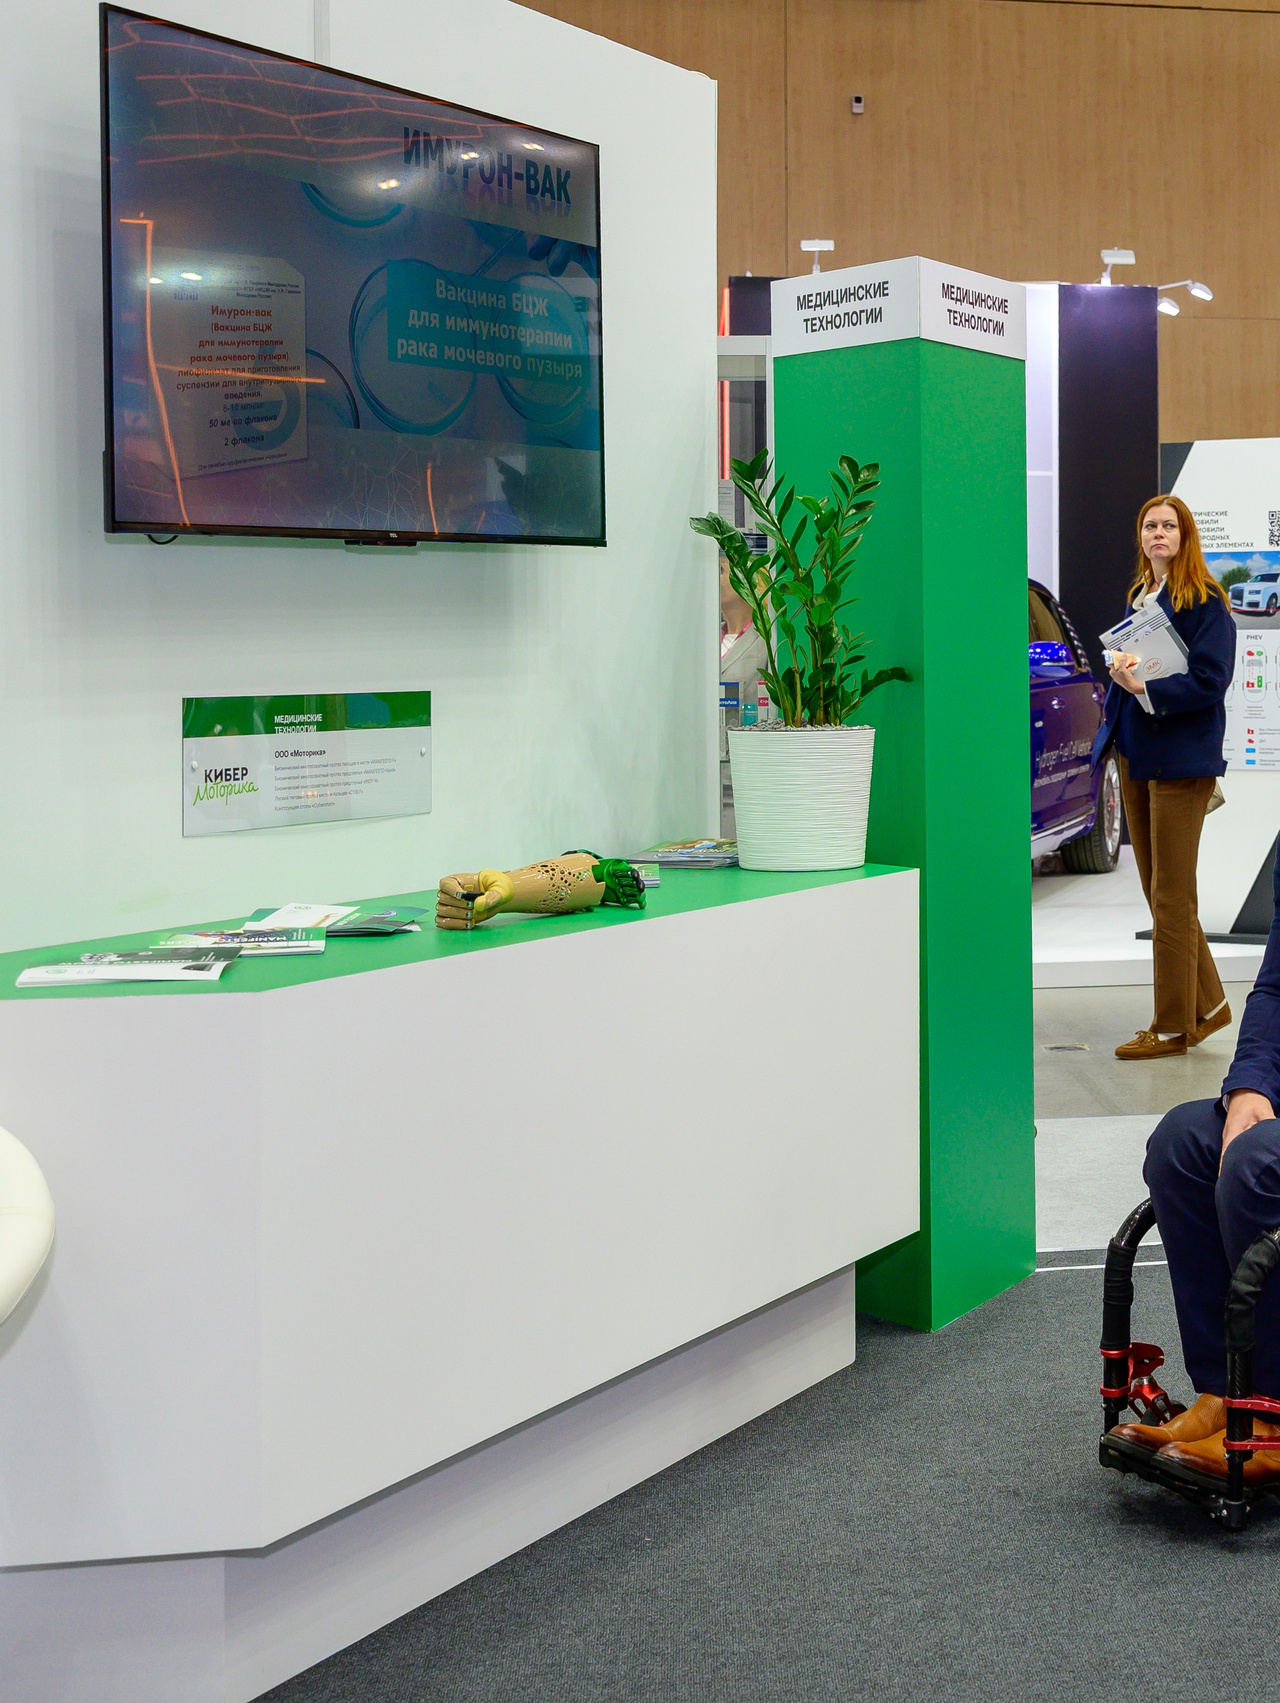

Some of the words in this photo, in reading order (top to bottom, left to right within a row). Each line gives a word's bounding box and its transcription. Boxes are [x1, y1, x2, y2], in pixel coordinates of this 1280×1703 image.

[403, 126, 572, 205] ИМУРОН-ВАК
[435, 278, 507, 310] Вакцина
[512, 292, 549, 319] БЦЖ
[796, 281, 889, 312] МЕДИЦИНСКИЕ
[941, 282, 1009, 316] МЕДИЦИНСКИЕ
[803, 307, 883, 334] ТЕХНОЛОГИИ
[946, 308, 1005, 338] ТЕХНОЛОГИИ
[210, 322, 250, 335] (Вакцина
[253, 322, 273, 333] БЦЖ
[408, 308, 440, 329] для
[445, 314, 573, 349] иммунотерапии
[198, 338, 215, 349] для
[217, 338, 284, 349] иммунотерапии
[190, 355, 213, 365] рака
[215, 353, 256, 363] мочевого
[397, 338, 438, 359] рака
[444, 344, 522, 370] мочевого
[527, 356, 583, 381] пузыря
[222, 379, 237, 390] для
[208, 418, 218, 429] 50
[224, 437, 229, 447] 2
[1215, 541, 1255, 549] ЭЛЕМЕНТАХ
[274, 713, 323, 725] МЕДИЦИНСКИЕ
[274, 725, 317, 735] ТЕХНОЛОГИИ
[274, 749, 289, 759] ООО
[290, 748, 327, 759] «Моторика»
[204, 767, 249, 784] КИБЕР
[193, 781, 260, 807] Моторика
